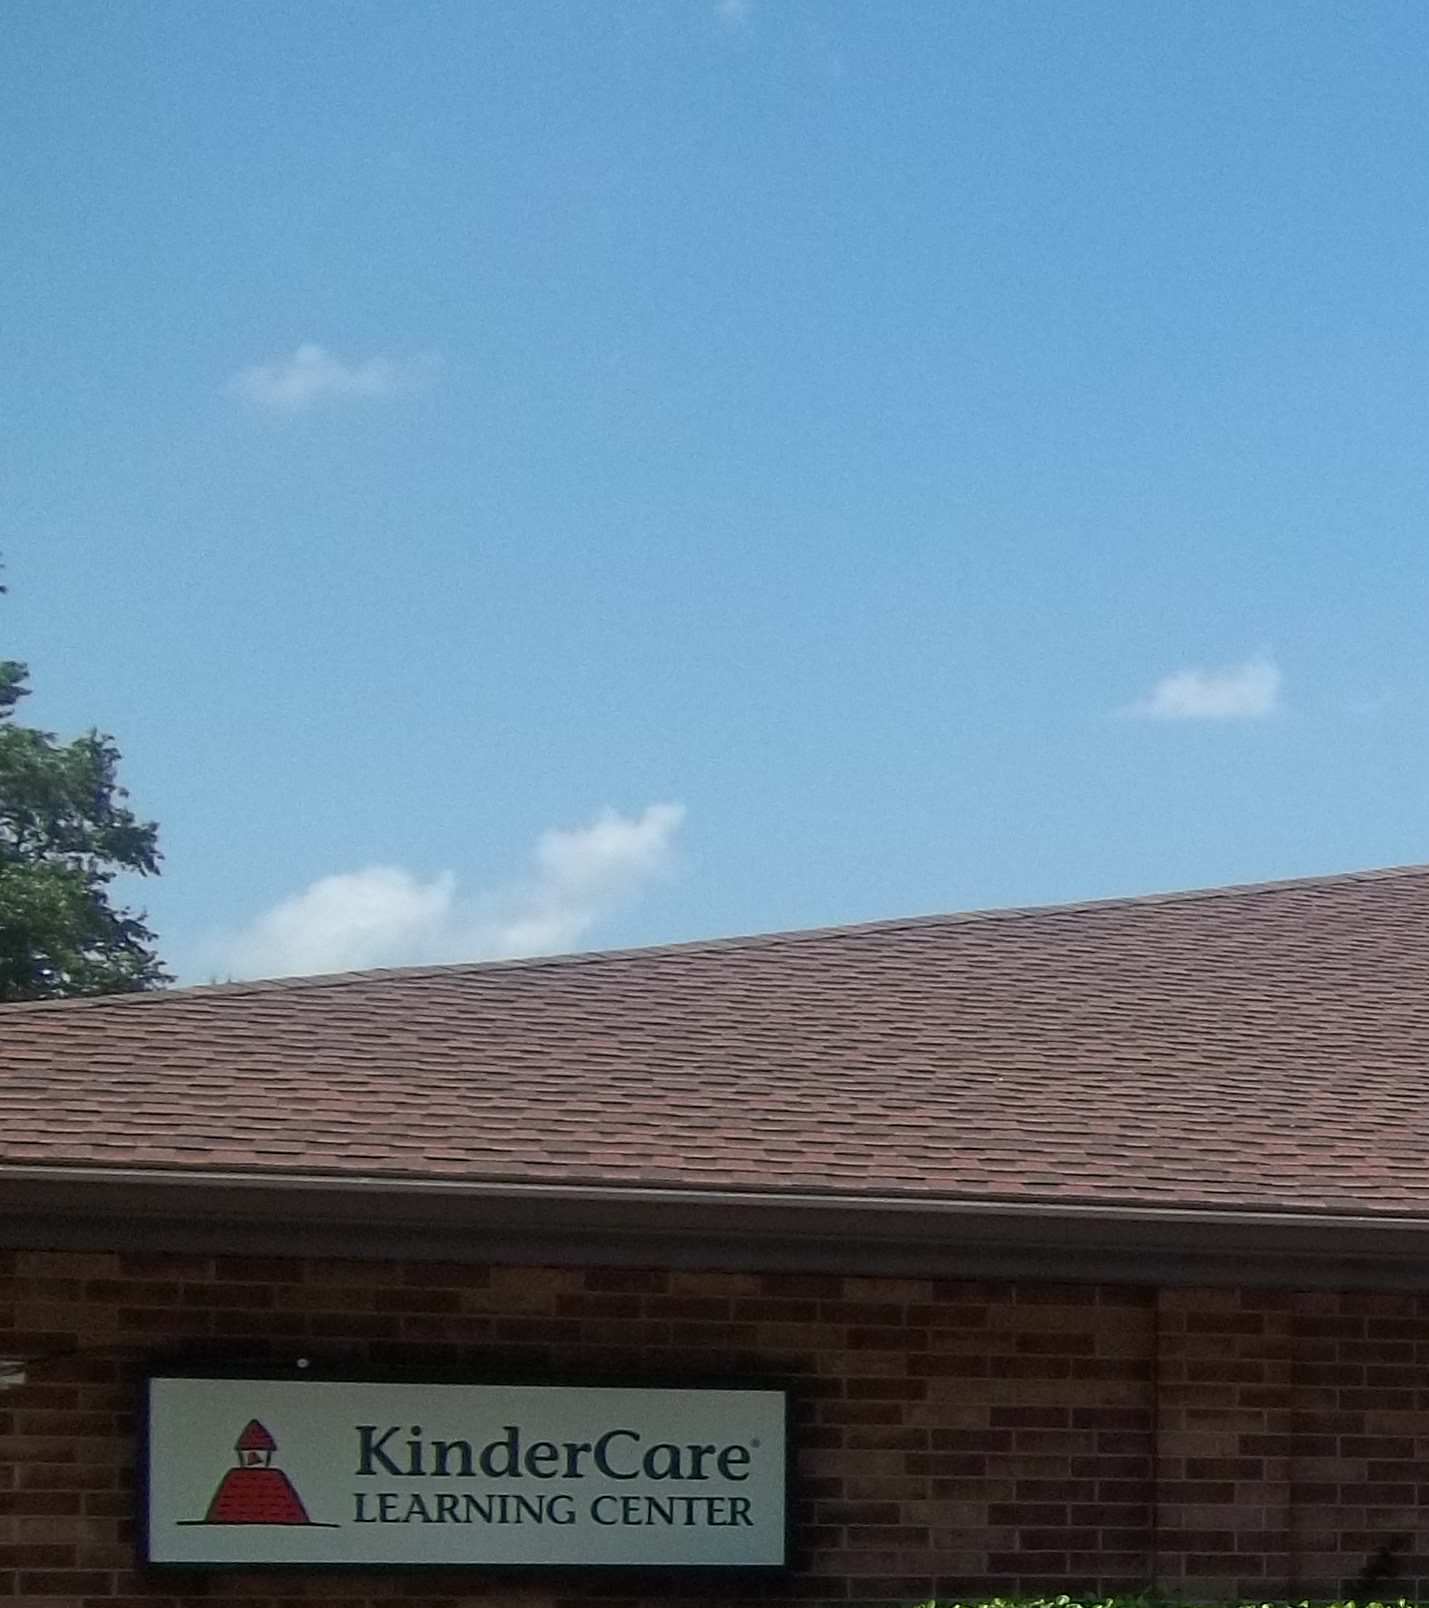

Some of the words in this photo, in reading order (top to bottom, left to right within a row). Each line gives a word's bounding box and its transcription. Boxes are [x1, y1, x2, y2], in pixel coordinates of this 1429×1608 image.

[354, 1425, 751, 1480] KinderCare
[353, 1493, 575, 1525] LEARNING
[590, 1495, 754, 1526] CENTER
